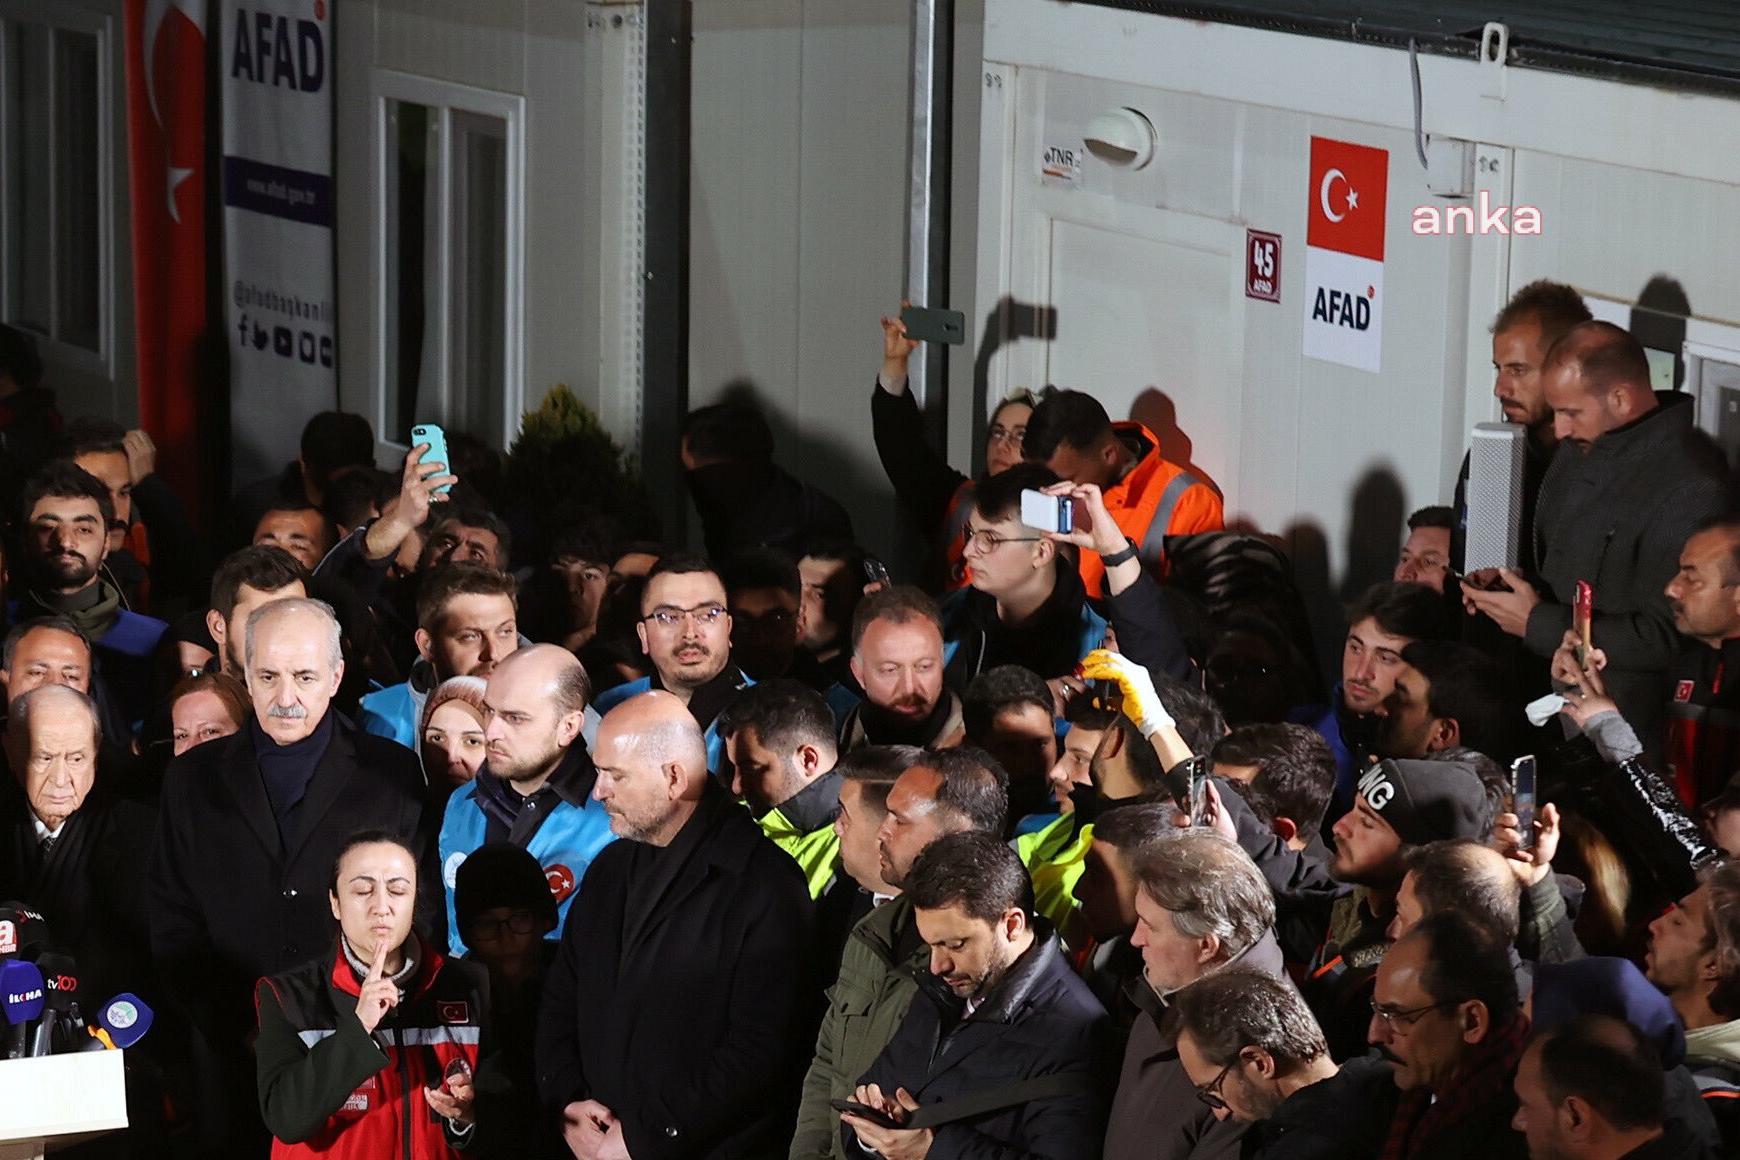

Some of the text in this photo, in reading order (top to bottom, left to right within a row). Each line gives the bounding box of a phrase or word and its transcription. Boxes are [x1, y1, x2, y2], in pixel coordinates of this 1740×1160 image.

[231, 8, 324, 92] AFAD
[1050, 147, 1074, 167] TNR
[1253, 240, 1274, 278] 45
[1311, 286, 1371, 331] AFAD
